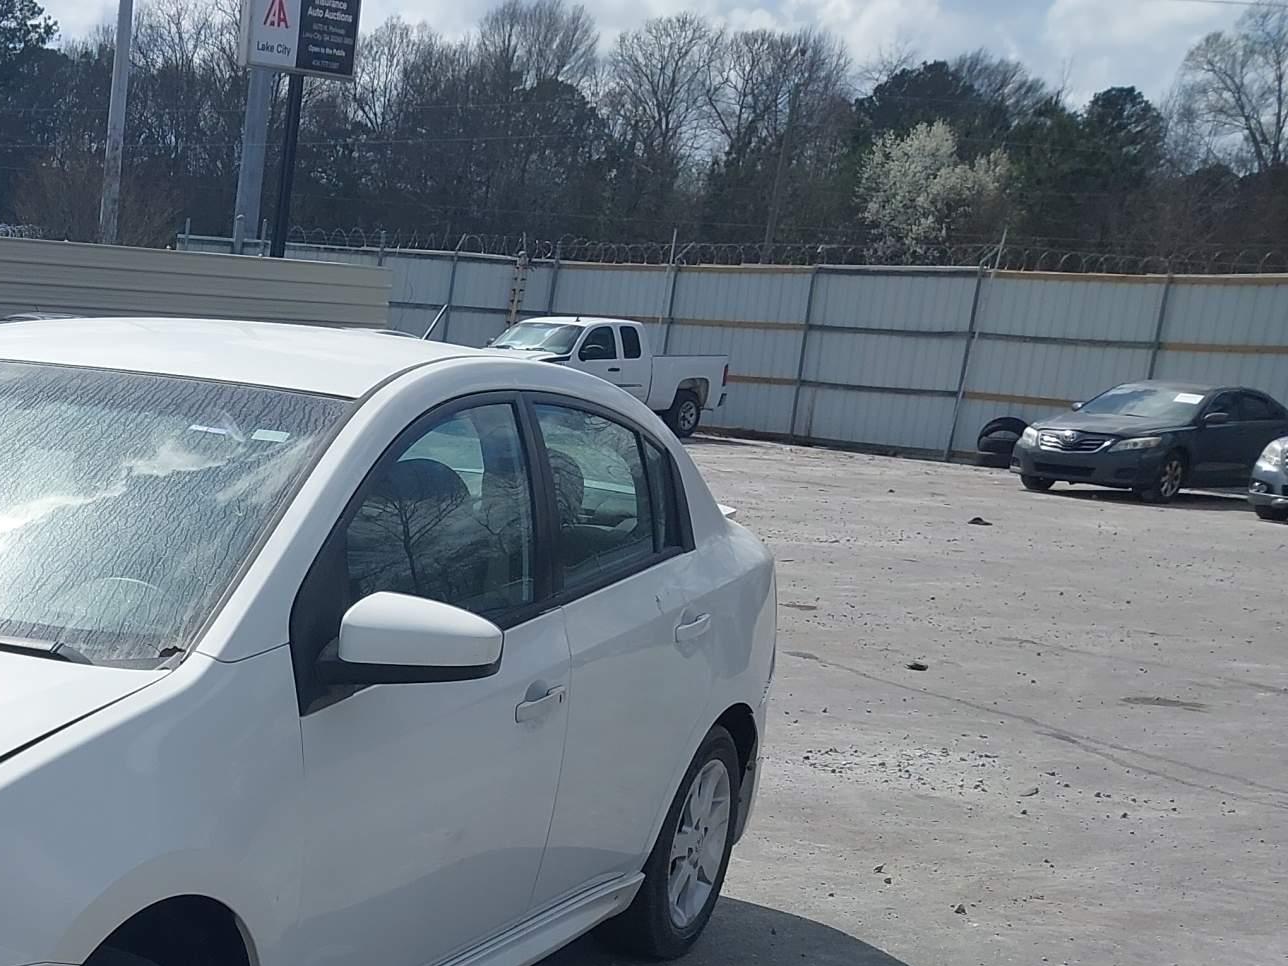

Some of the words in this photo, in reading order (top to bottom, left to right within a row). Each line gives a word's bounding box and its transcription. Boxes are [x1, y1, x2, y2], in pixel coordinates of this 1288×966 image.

[307, 6, 323, 17] Auto
[324, 9, 353, 22] Auctions
[256, 40, 275, 53] Lake
[276, 43, 291, 56] City
